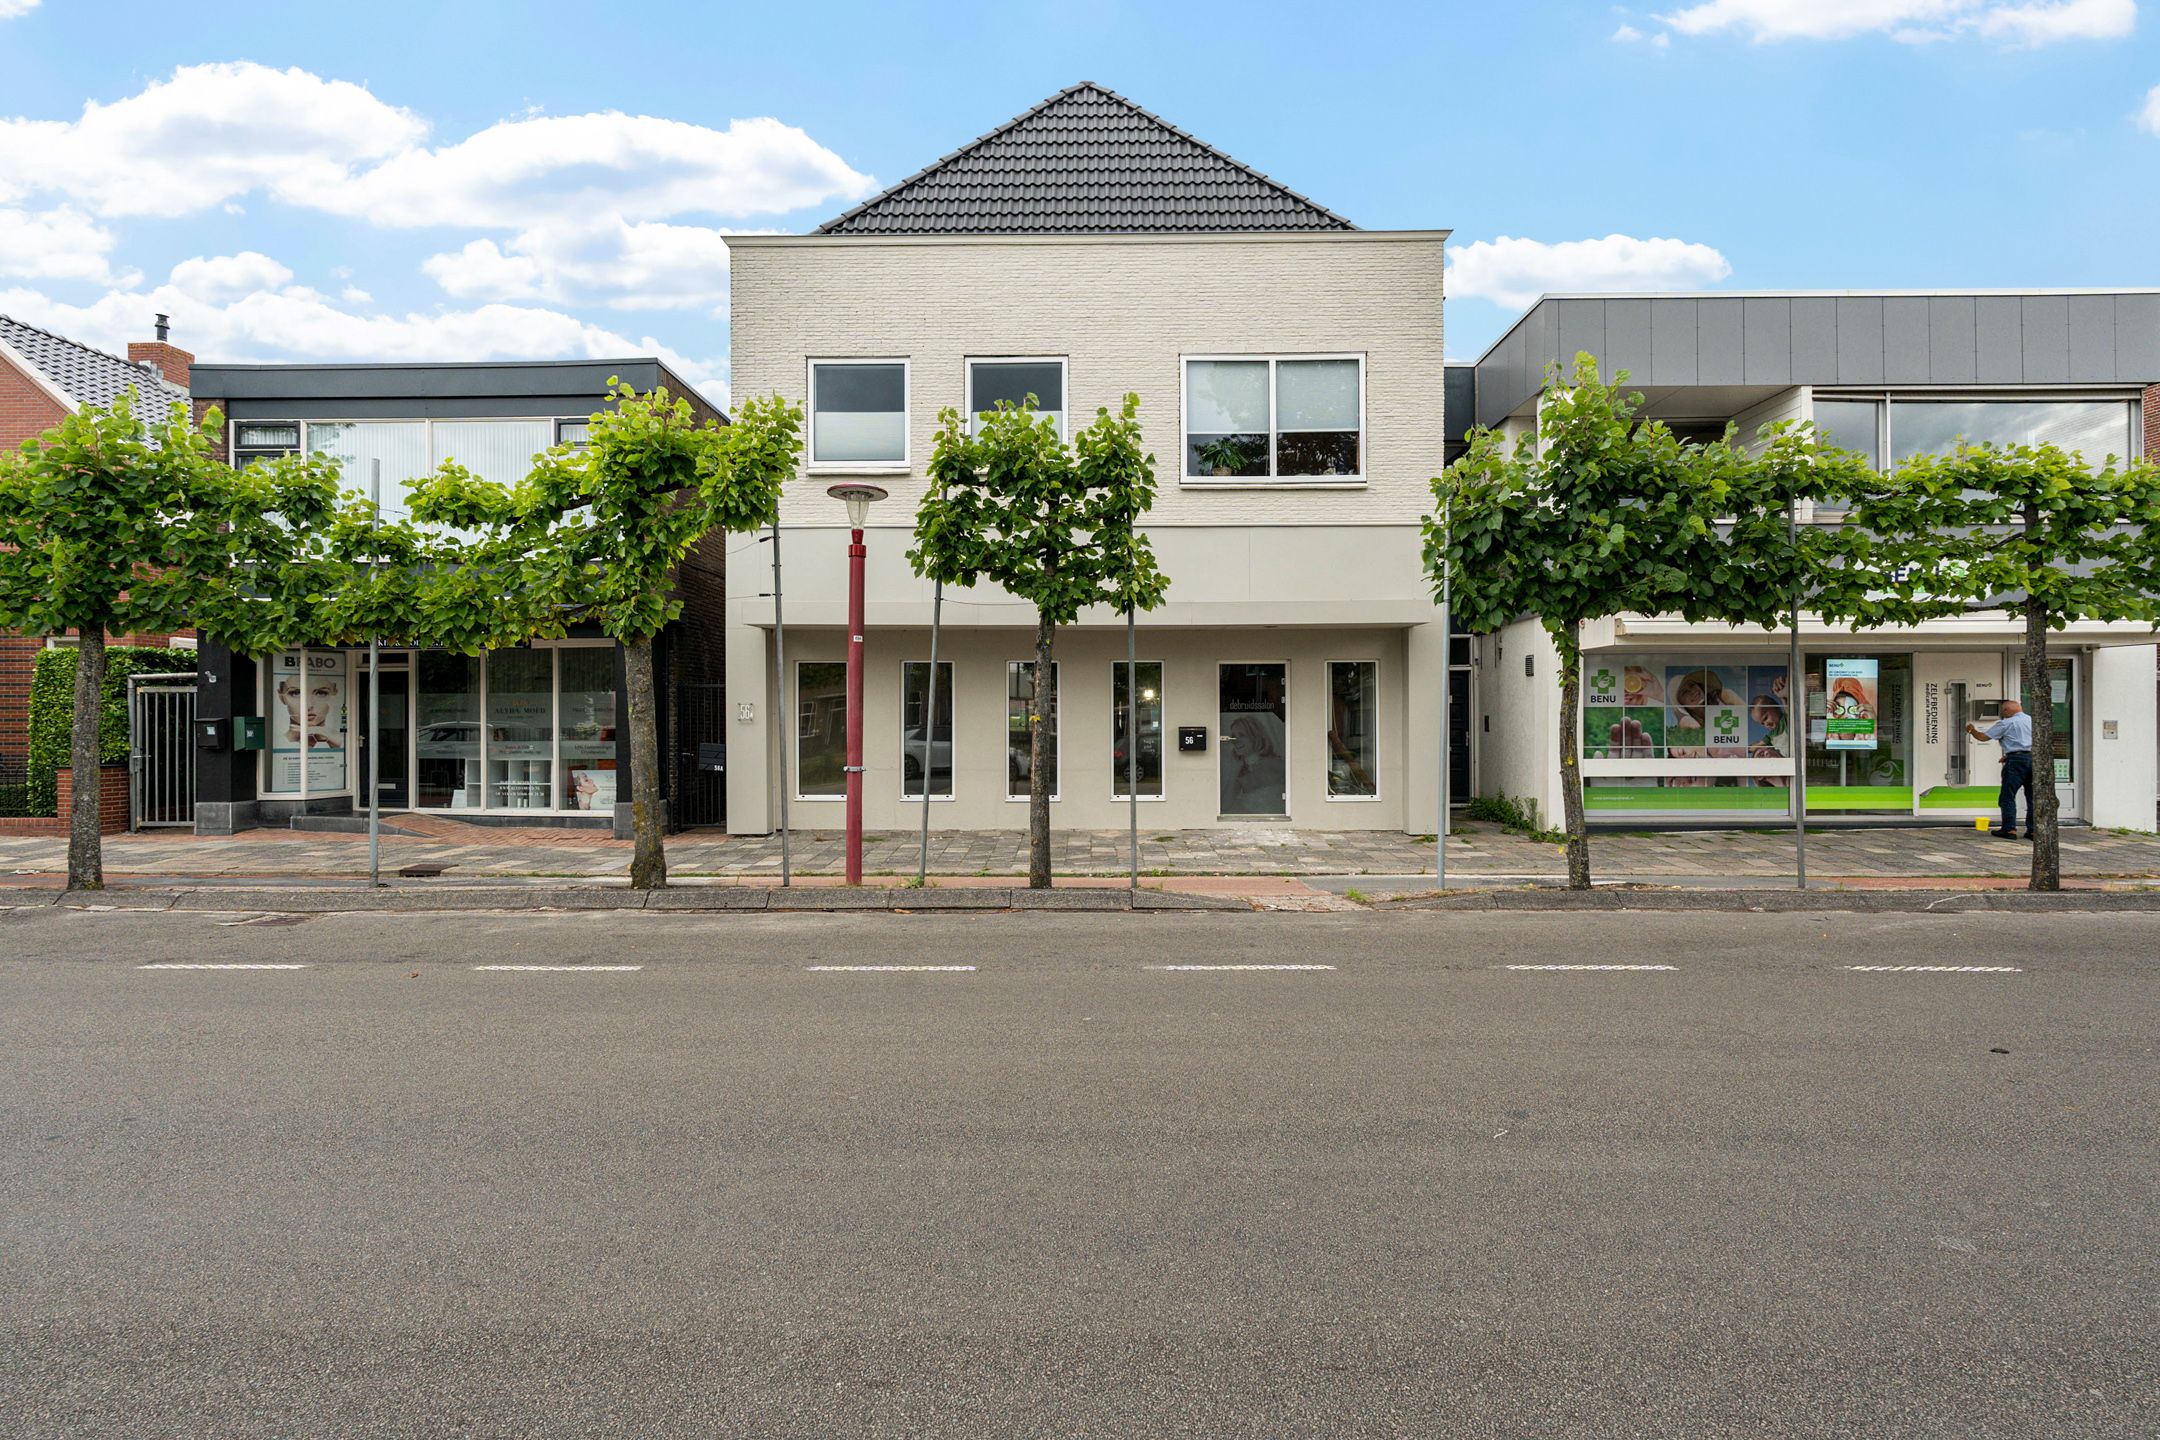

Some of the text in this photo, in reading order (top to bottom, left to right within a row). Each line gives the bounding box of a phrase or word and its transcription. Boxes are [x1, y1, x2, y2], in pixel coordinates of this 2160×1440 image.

[1590, 695, 1616, 703] BENU
[1230, 699, 1275, 710] debruidssalon
[1185, 736, 1194, 745] 56
[1713, 735, 1740, 744] BENU
